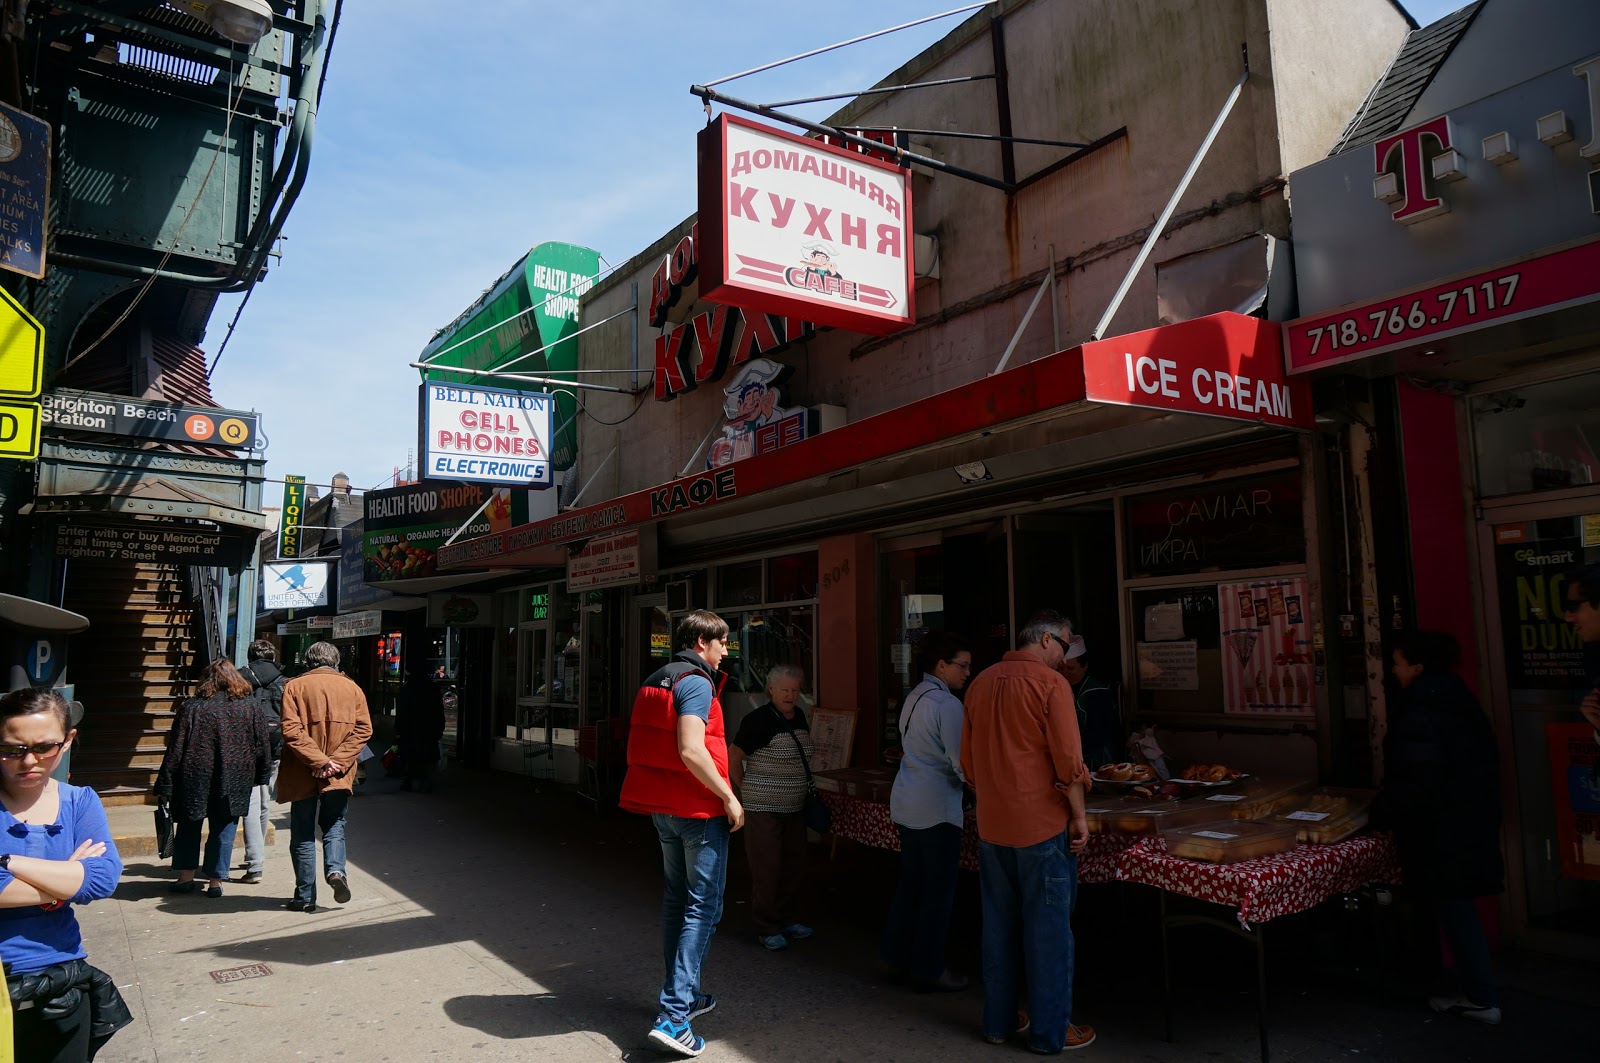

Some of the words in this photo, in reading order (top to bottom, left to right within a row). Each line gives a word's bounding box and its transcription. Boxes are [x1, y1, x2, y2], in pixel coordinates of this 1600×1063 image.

[1373, 115, 1454, 222] T
[731, 149, 901, 222] ДОМАШНЯЯ
[12, 193, 39, 211] AREA
[730, 181, 902, 259] КУХНЯ
[534, 264, 567, 293] HEALTH
[786, 266, 857, 301] CAFE
[544, 293, 579, 323] SHOPPE
[1307, 272, 1522, 356] 718.766.7117
[654, 305, 806, 402] КУХ
[1124, 352, 1181, 399] ICE
[1192, 367, 1293, 420] CREAM
[41, 394, 116, 416] Brighton
[123, 404, 177, 423] Beach
[434, 387, 478, 405] BELL
[483, 391, 545, 412] NATION
[0, 413, 18, 442] D
[41, 408, 106, 429] Station
[192, 419, 207, 435] B
[226, 423, 241, 439] Q
[459, 409, 520, 433] CELL
[438, 430, 540, 456] PHONES
[435, 457, 545, 479] ELECTRONICS
[368, 493, 406, 520] HEALTH
[408, 490, 438, 514] FOOD
[440, 485, 484, 510] SHOPPE
[650, 468, 737, 517] КАФЕ
[591, 503, 627, 530] САМСА
[1167, 489, 1273, 526] CAVIAR
[283, 486, 300, 556] LIQUORS
[369, 534, 399, 545] NATURAL
[406, 530, 440, 541] ORGANIC
[469, 523, 491, 534] FOOD
[57, 537, 69, 546] at
[74, 537, 87, 547] all
[92, 537, 123, 549] times
[127, 542, 140, 550] or
[143, 543, 165, 552] see
[169, 544, 199, 556] agent
[203, 545, 215, 555] at
[58, 526, 90, 537] Enter
[94, 528, 119, 538] with
[122, 531, 135, 540] or
[138, 530, 159, 544] buy
[163, 532, 220, 546] MetroCard
[480, 534, 503, 558] STORE
[56, 545, 105, 559] Brighton
[109, 549, 116, 558] 7
[121, 549, 156, 561] Street
[1526, 550, 1575, 566] smart
[268, 594, 295, 602] UNITED
[298, 591, 325, 600] STATES
[268, 600, 289, 608] POST
[292, 599, 318, 607] OFFICE
[532, 594, 548, 606] JUICE
[533, 607, 548, 619] BAR
[36, 640, 52, 679] P
